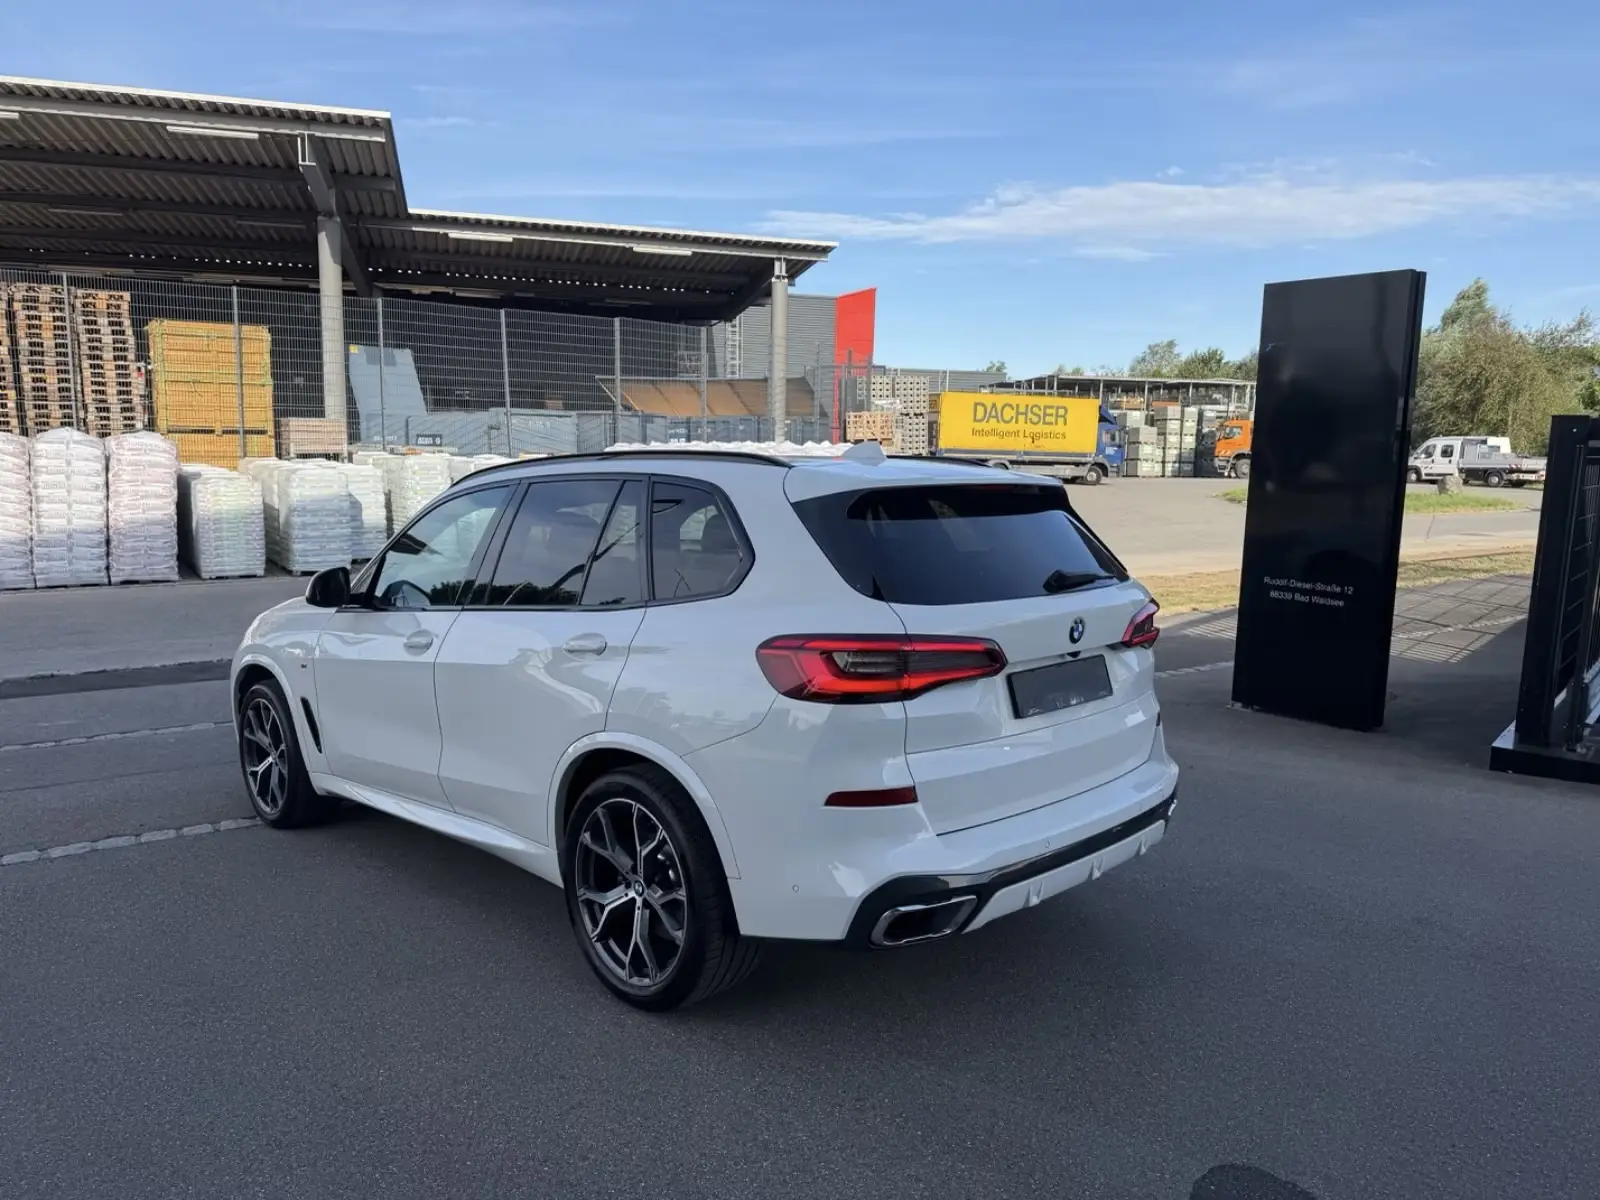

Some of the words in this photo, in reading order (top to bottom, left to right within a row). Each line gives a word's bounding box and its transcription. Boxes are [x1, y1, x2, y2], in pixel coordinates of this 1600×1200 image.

[973, 402, 1068, 426] DACHSER
[971, 428, 1020, 440] Intelligent
[1023, 429, 1067, 441] Logistics
[1344, 586, 1354, 595] 12
[1294, 593, 1310, 602] Bad
[1311, 595, 1345, 607] Waldsee
